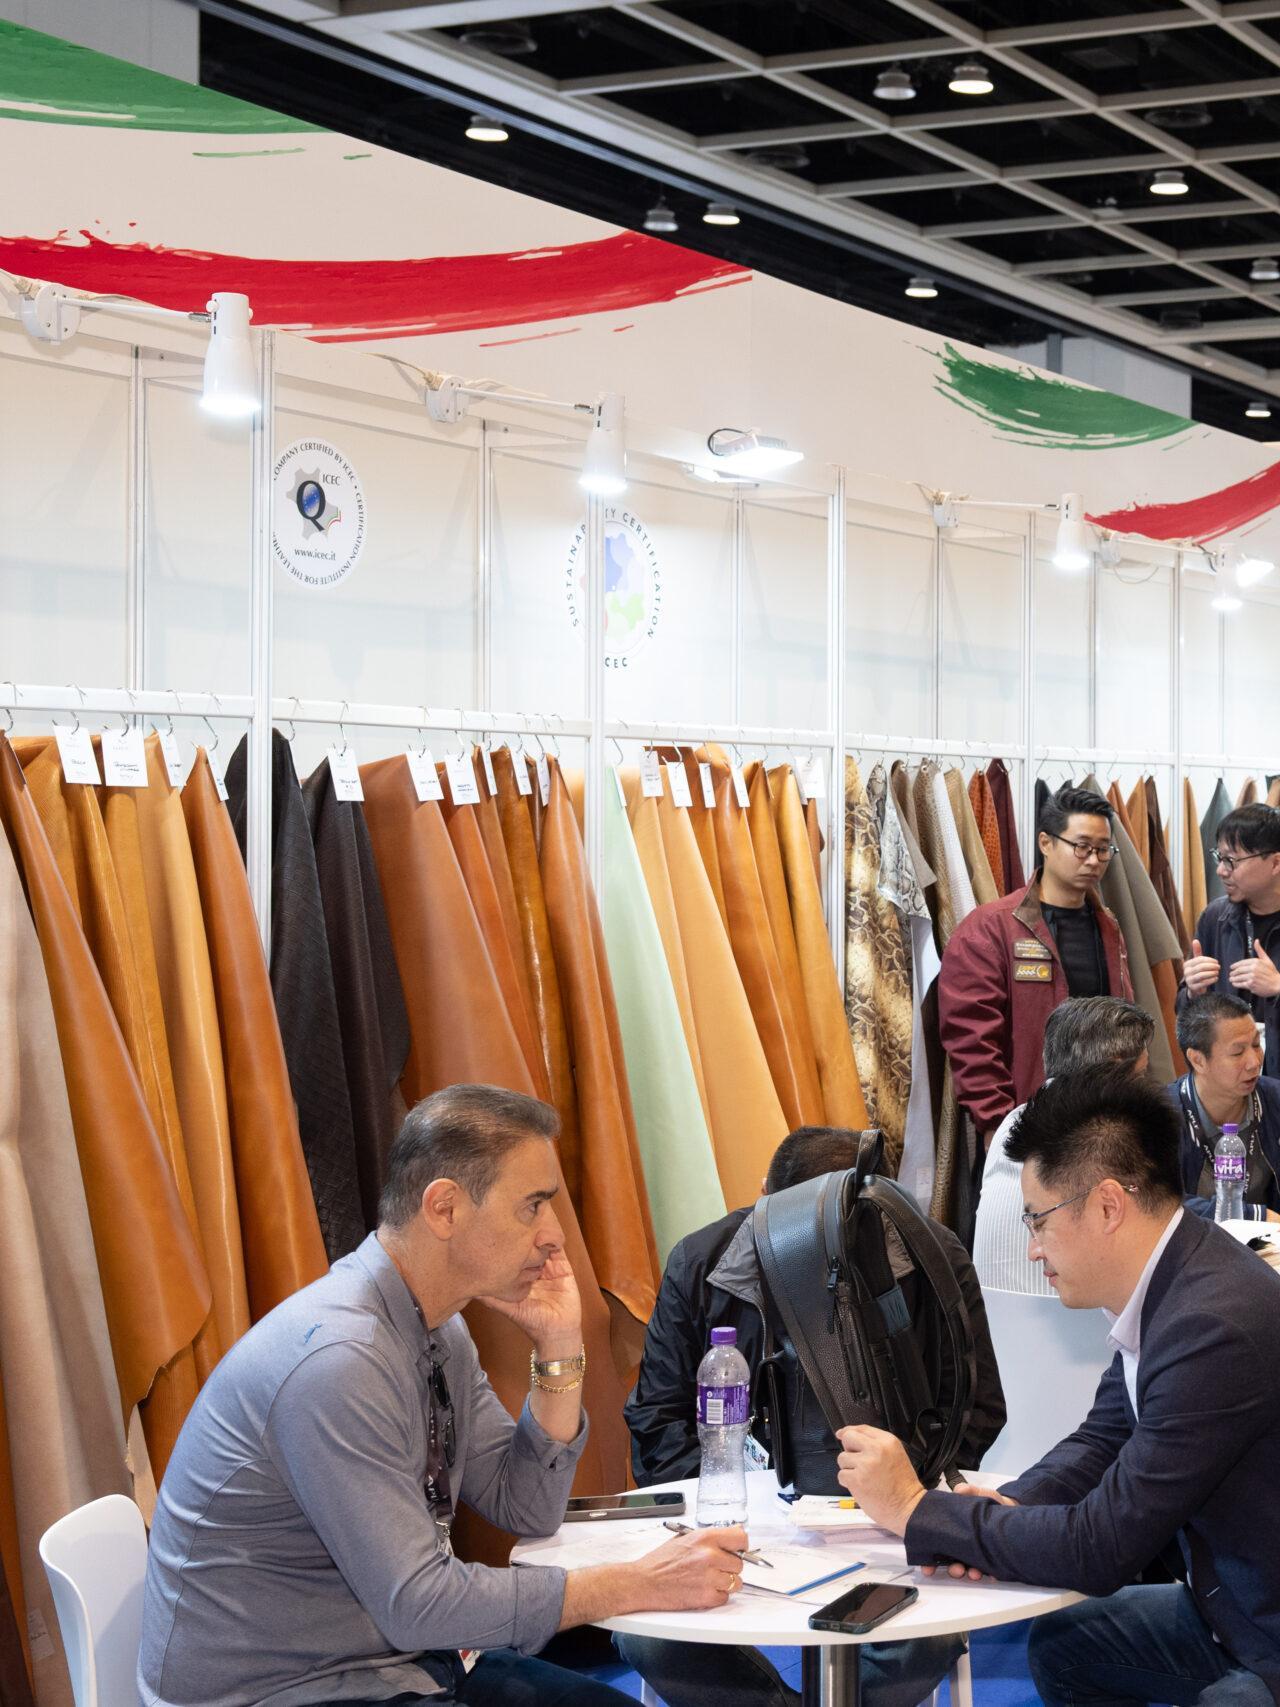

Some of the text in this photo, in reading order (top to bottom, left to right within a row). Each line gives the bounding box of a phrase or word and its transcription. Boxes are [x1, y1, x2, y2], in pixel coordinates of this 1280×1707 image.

[300, 441, 334, 457] CERTIFIED
[334, 453, 343, 464] BY
[322, 474, 341, 486] ICEC
[294, 548, 337, 561] www.icec.it
[605, 657, 628, 668] CEC
